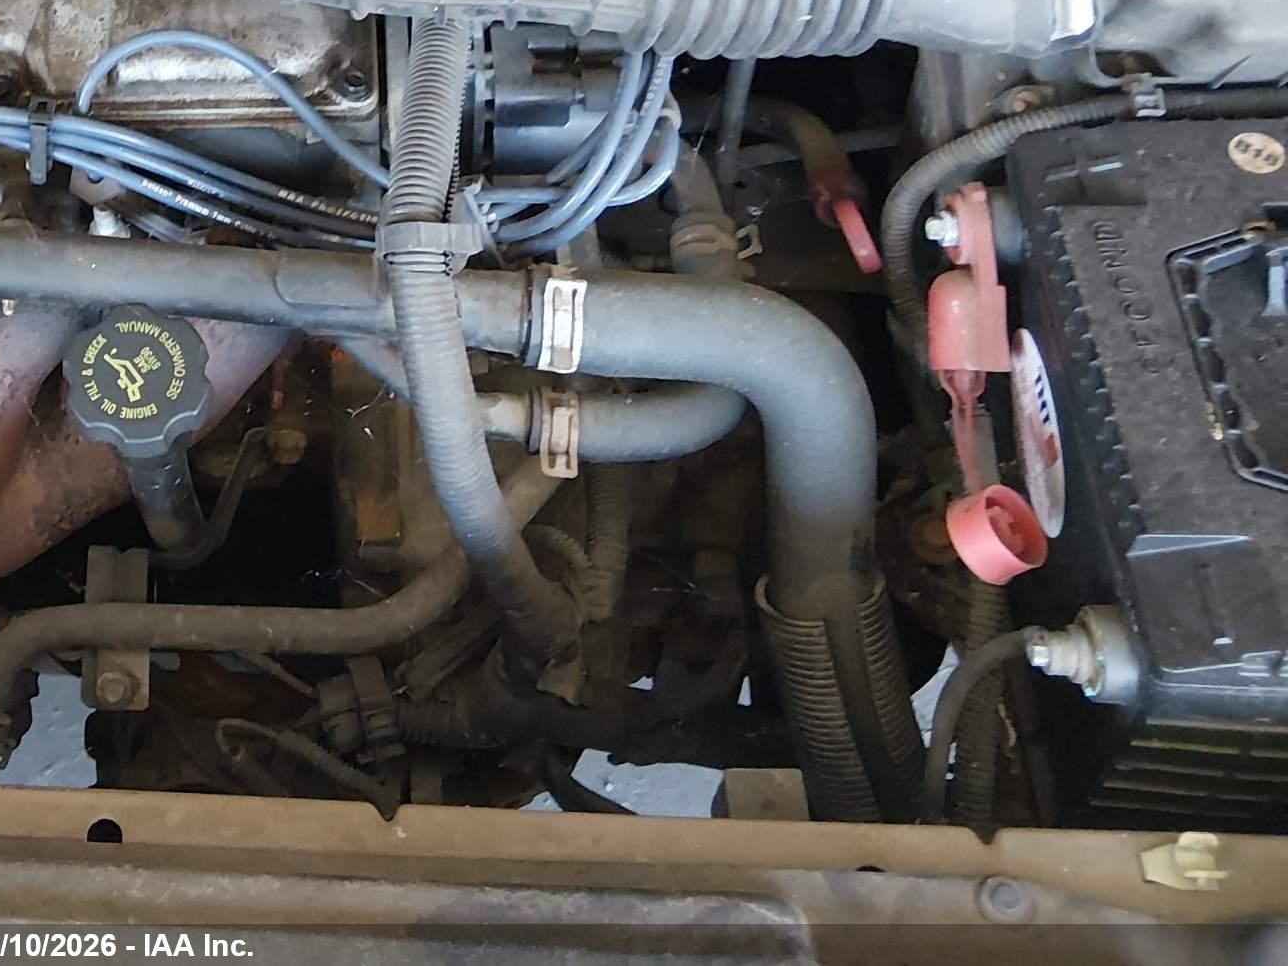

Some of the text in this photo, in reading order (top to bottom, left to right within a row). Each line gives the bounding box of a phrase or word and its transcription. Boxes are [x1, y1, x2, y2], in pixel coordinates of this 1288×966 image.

[114, 321, 162, 338] MANUAL
[133, 355, 149, 374] SAE
[81, 334, 158, 419] ENGINE OIL FILL & CHECK
[166, 378, 185, 400] SEE
